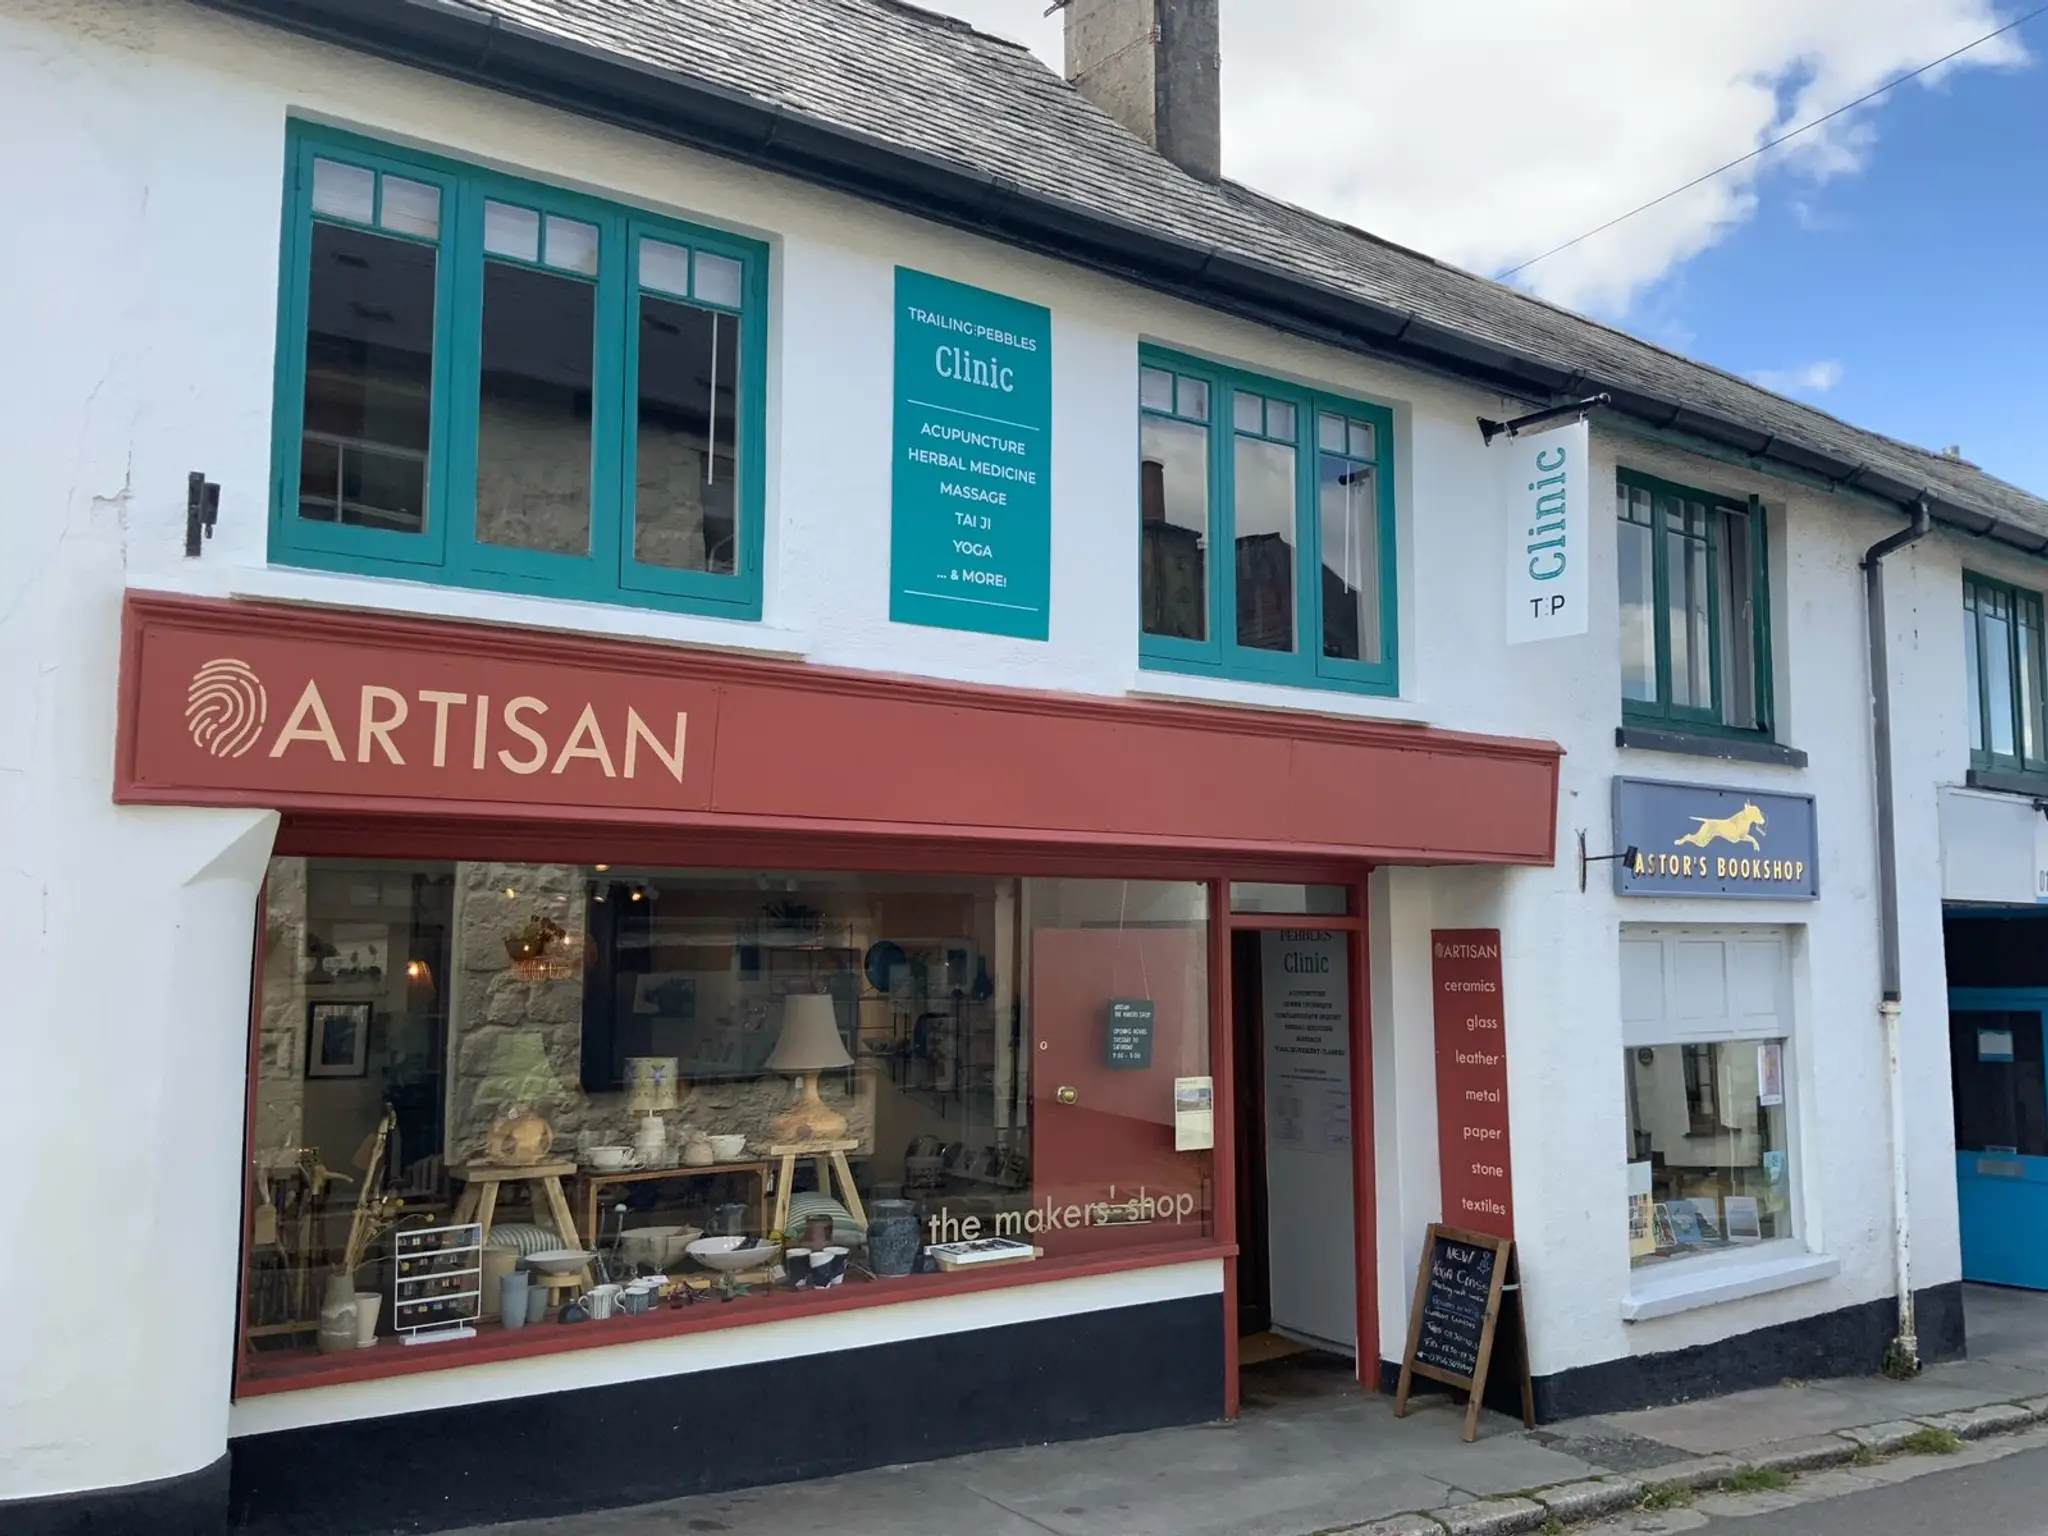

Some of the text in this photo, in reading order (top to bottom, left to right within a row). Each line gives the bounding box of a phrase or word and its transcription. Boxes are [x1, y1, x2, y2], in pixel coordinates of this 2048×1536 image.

[935, 345, 1014, 392] Clinic
[921, 422, 1026, 455] ACUPUNCTURE
[908, 447, 1037, 484] HERBAL MEDICINE
[940, 481, 1007, 506] MASSAGE
[955, 512, 992, 530] TAI JI
[1527, 447, 1566, 581] Clinic
[953, 540, 993, 558] YOGA
[949, 569, 959, 581] &
[962, 569, 1007, 588] MORE!
[268, 678, 688, 784] ARTISAN
[1634, 853, 1803, 881] ASTOR'S BOOKSHOP
[1443, 944, 1498, 959] ARTISAN
[1284, 952, 1329, 974] Clinic
[1444, 979, 1496, 992] ceramics
[1466, 1014, 1498, 1031] glass
[1455, 1049, 1499, 1065] leather
[1465, 1089, 1500, 1102] metal
[1463, 1126, 1502, 1141] paper
[1471, 1162, 1503, 1177] stone
[1461, 1197, 1506, 1215] textiles
[928, 1206, 981, 1245] the
[1128, 1186, 1194, 1225] shop
[1445, 1246, 1476, 1264] NEW
